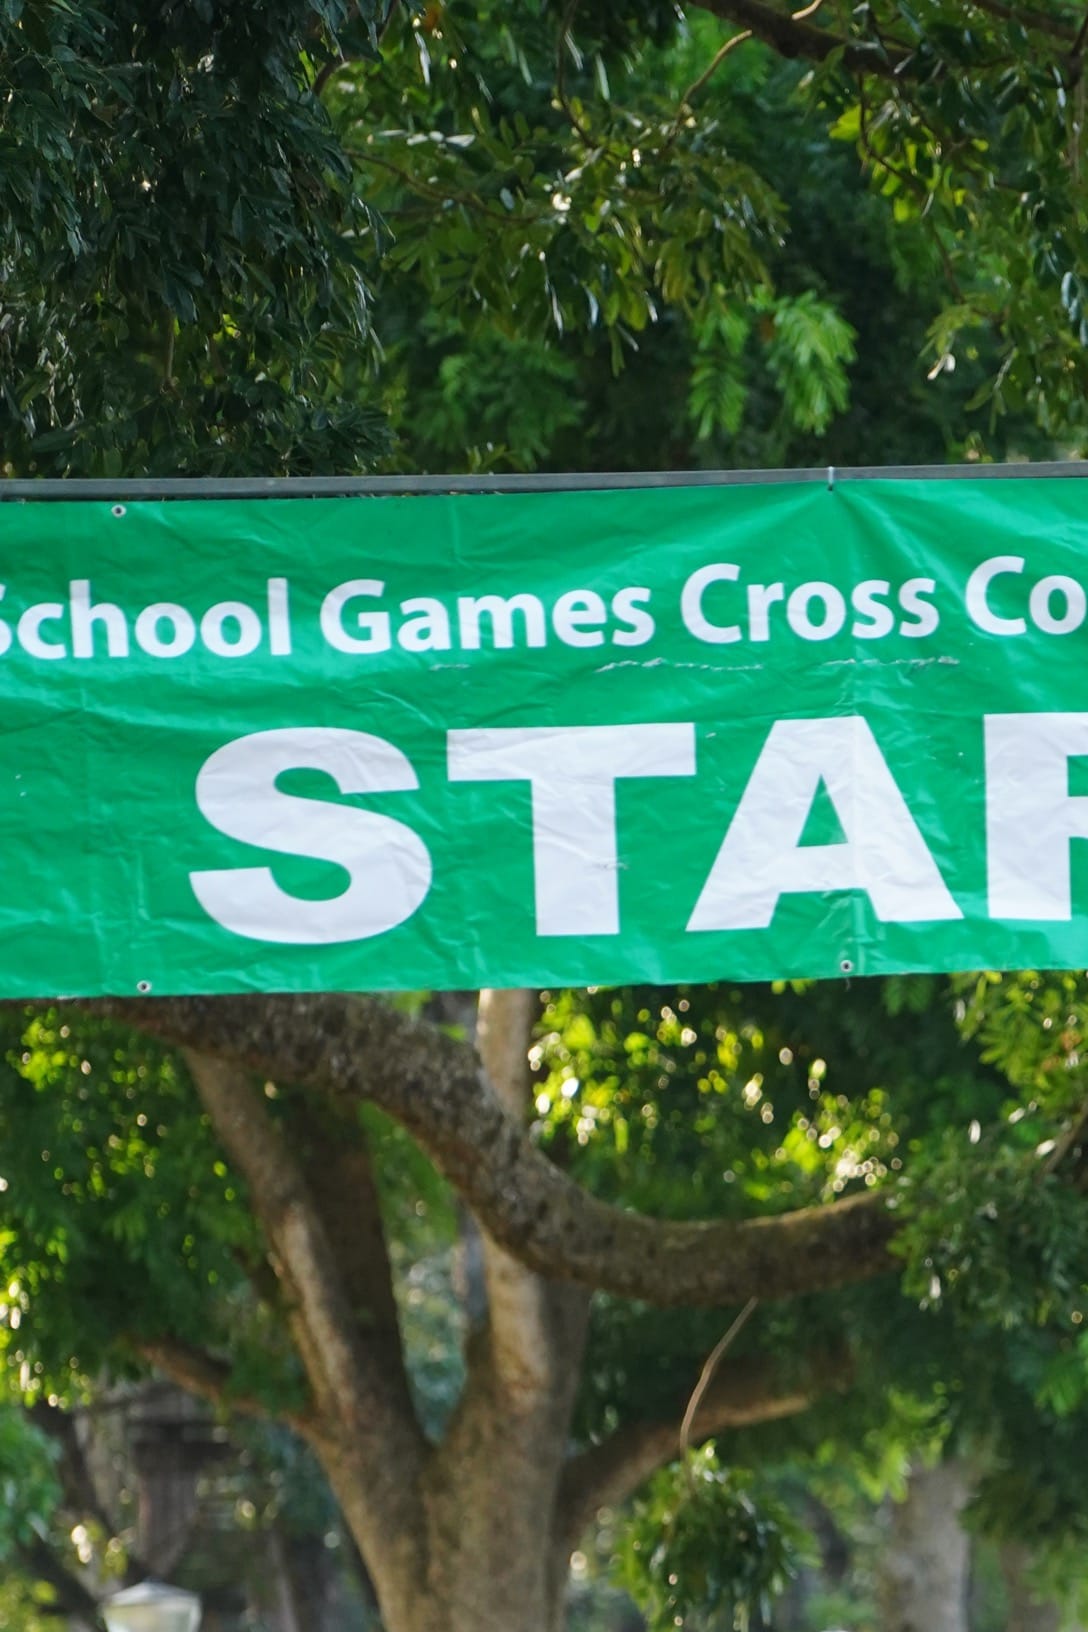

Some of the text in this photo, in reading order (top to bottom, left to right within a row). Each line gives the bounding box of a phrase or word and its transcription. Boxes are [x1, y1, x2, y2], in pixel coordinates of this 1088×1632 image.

[0, 579, 291, 660] chool
[320, 579, 654, 655] Games
[681, 563, 938, 643] Cross
